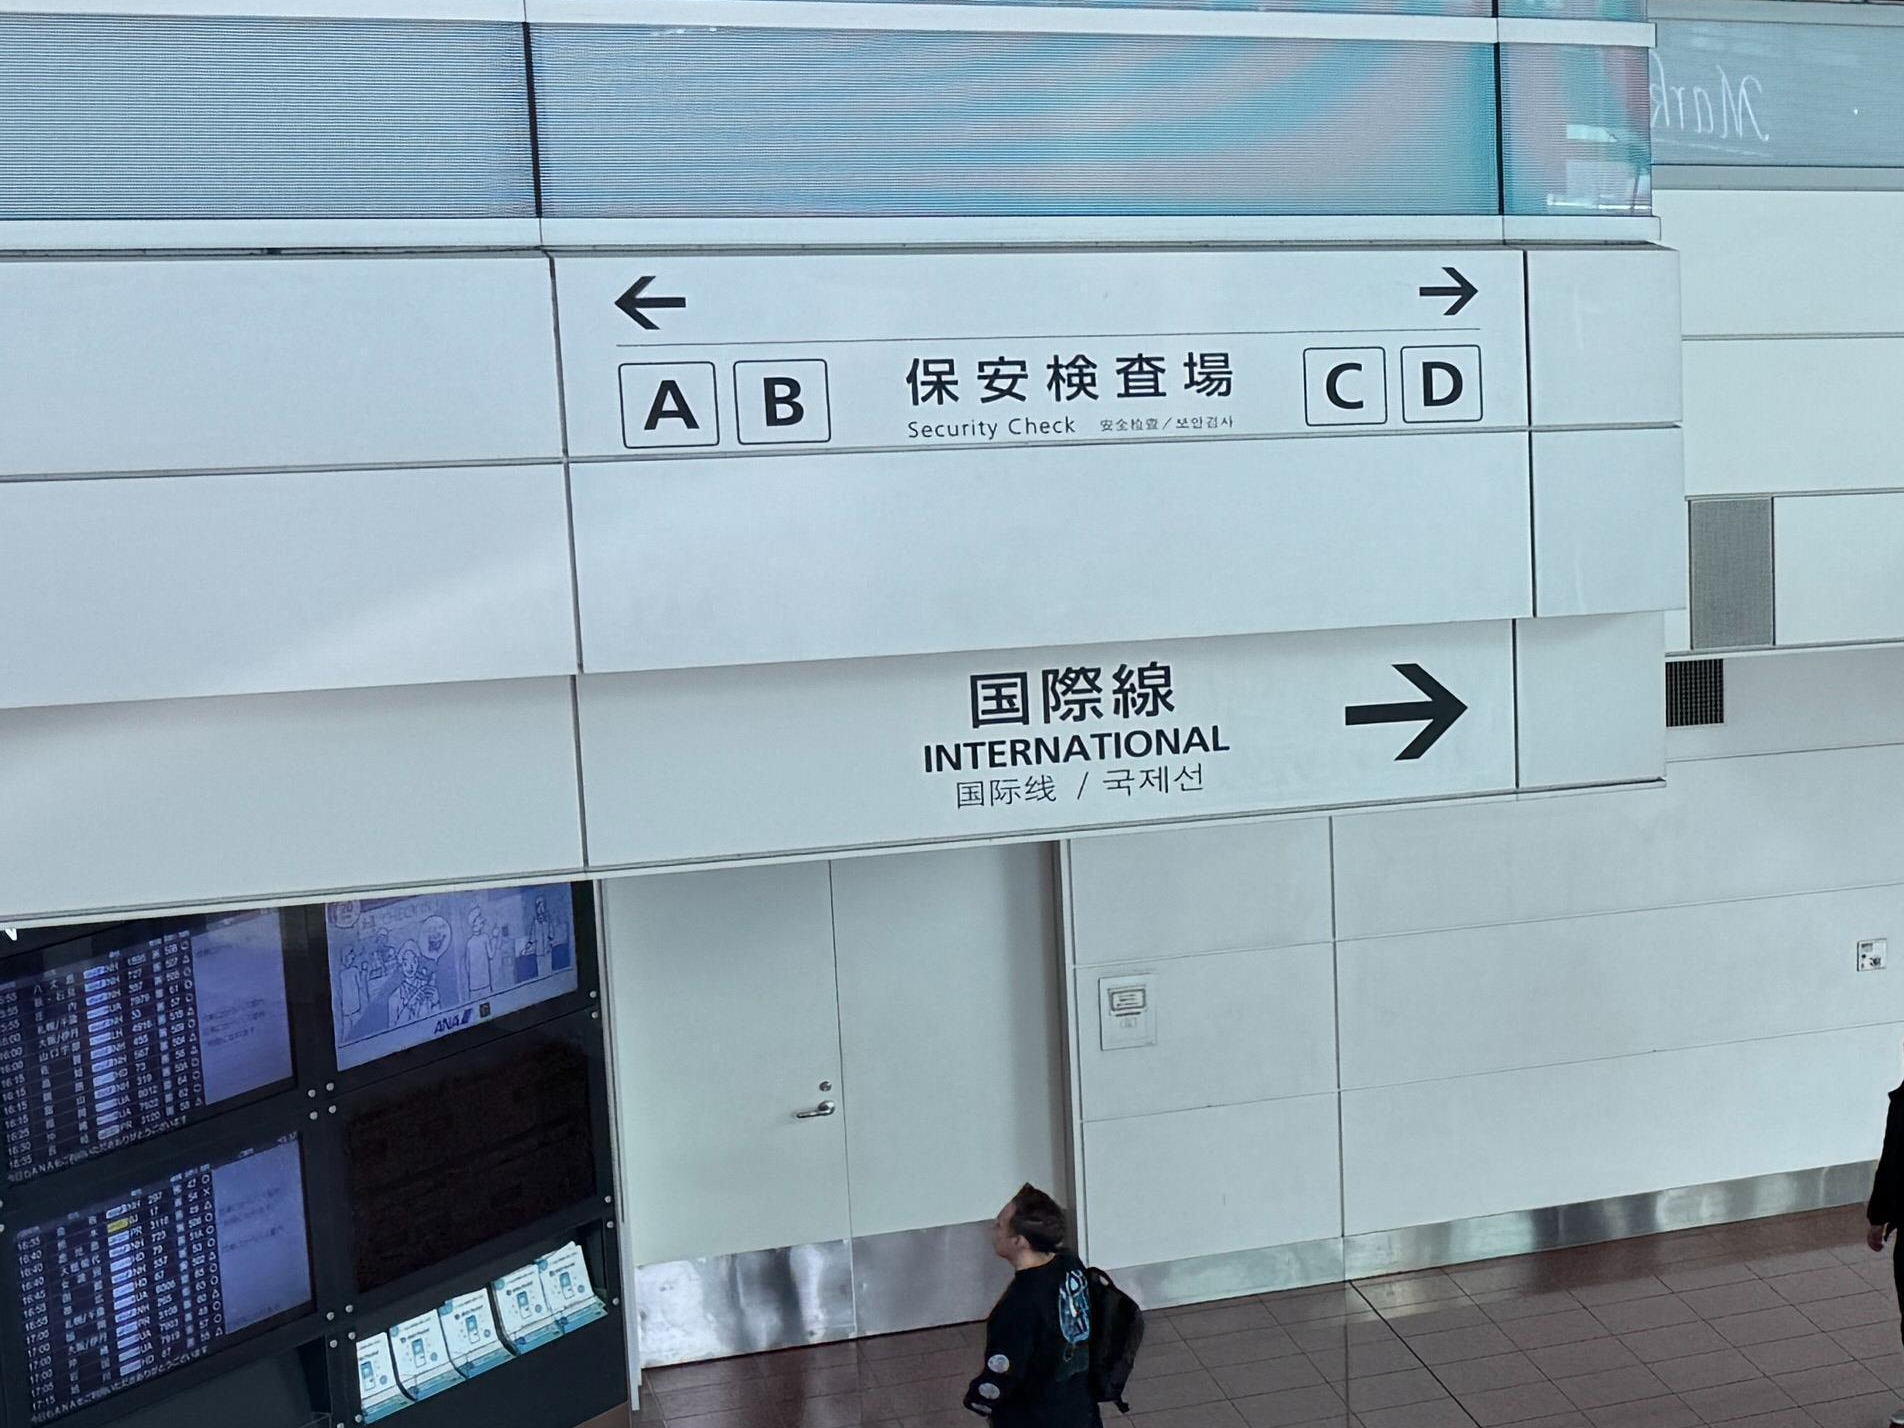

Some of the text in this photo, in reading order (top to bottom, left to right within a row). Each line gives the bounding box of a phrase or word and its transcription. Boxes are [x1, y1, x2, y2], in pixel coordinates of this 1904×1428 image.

[763, 376, 804, 427] B
[906, 352, 1233, 406] 保安検査場
[1325, 362, 1364, 410] C
[1422, 361, 1463, 407] D
[644, 380, 700, 430] A
[907, 415, 1076, 440] Security Check
[970, 661, 1175, 729] 国際線
[924, 725, 1231, 773] INTERNATIONAL
[956, 774, 1057, 809] 国际线
[1102, 762, 1205, 796] 국제선
